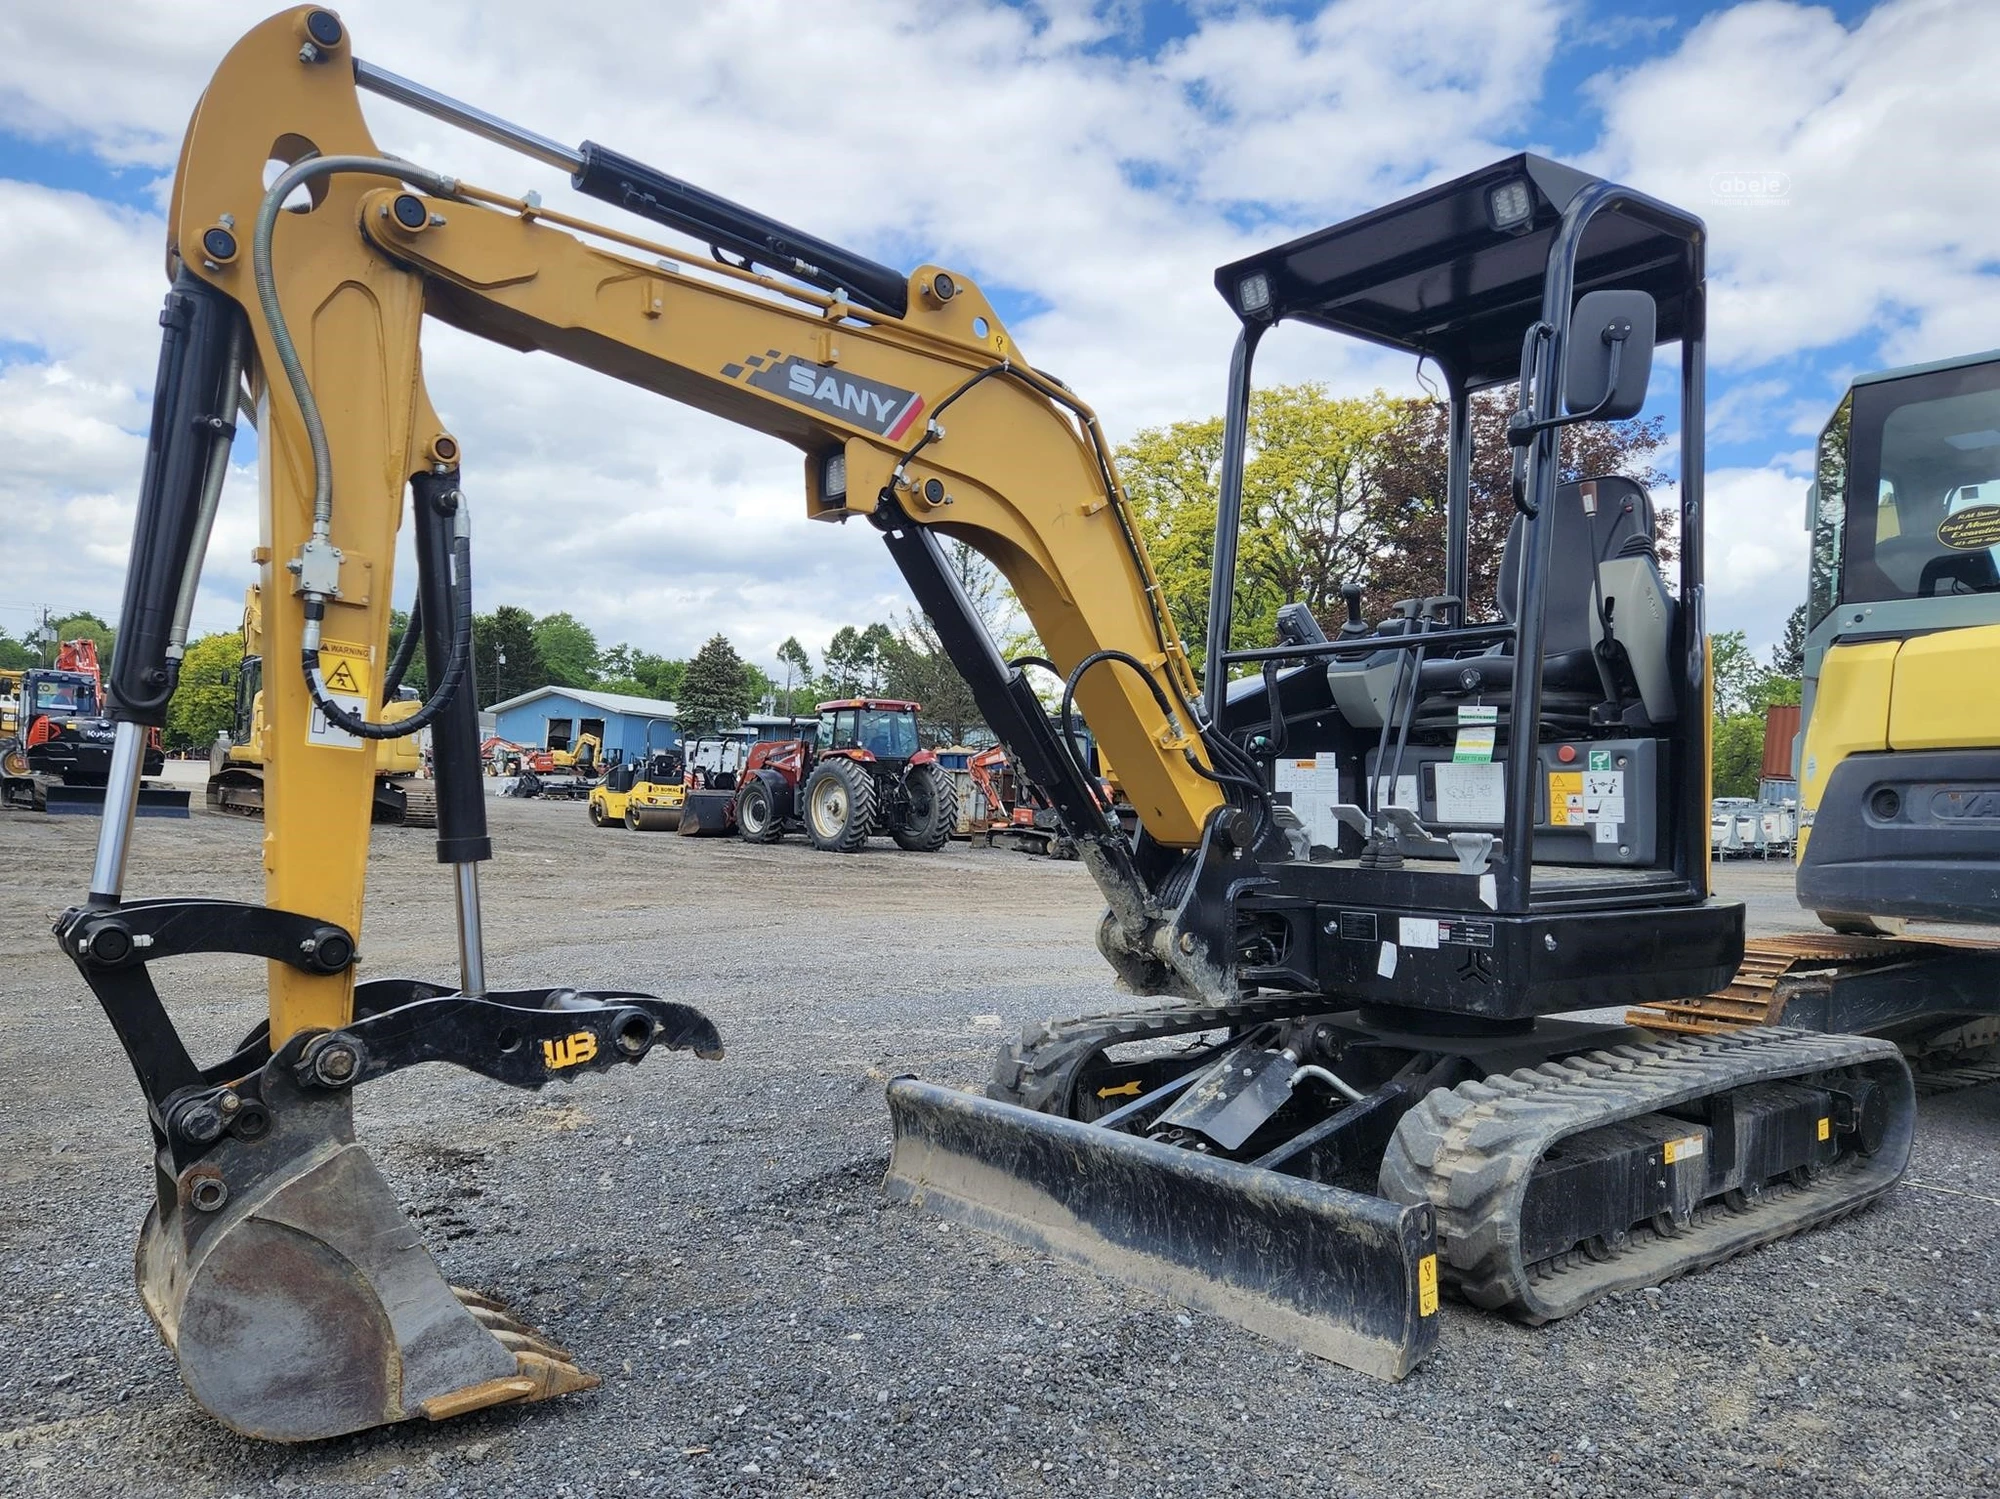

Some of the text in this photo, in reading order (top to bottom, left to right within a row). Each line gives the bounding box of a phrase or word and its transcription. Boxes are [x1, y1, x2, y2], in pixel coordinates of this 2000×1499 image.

[789, 364, 896, 423] SANY
[1966, 518, 2000, 529] Mount
[331, 645, 369, 658] WARNING
[87, 730, 117, 738] Kubot
